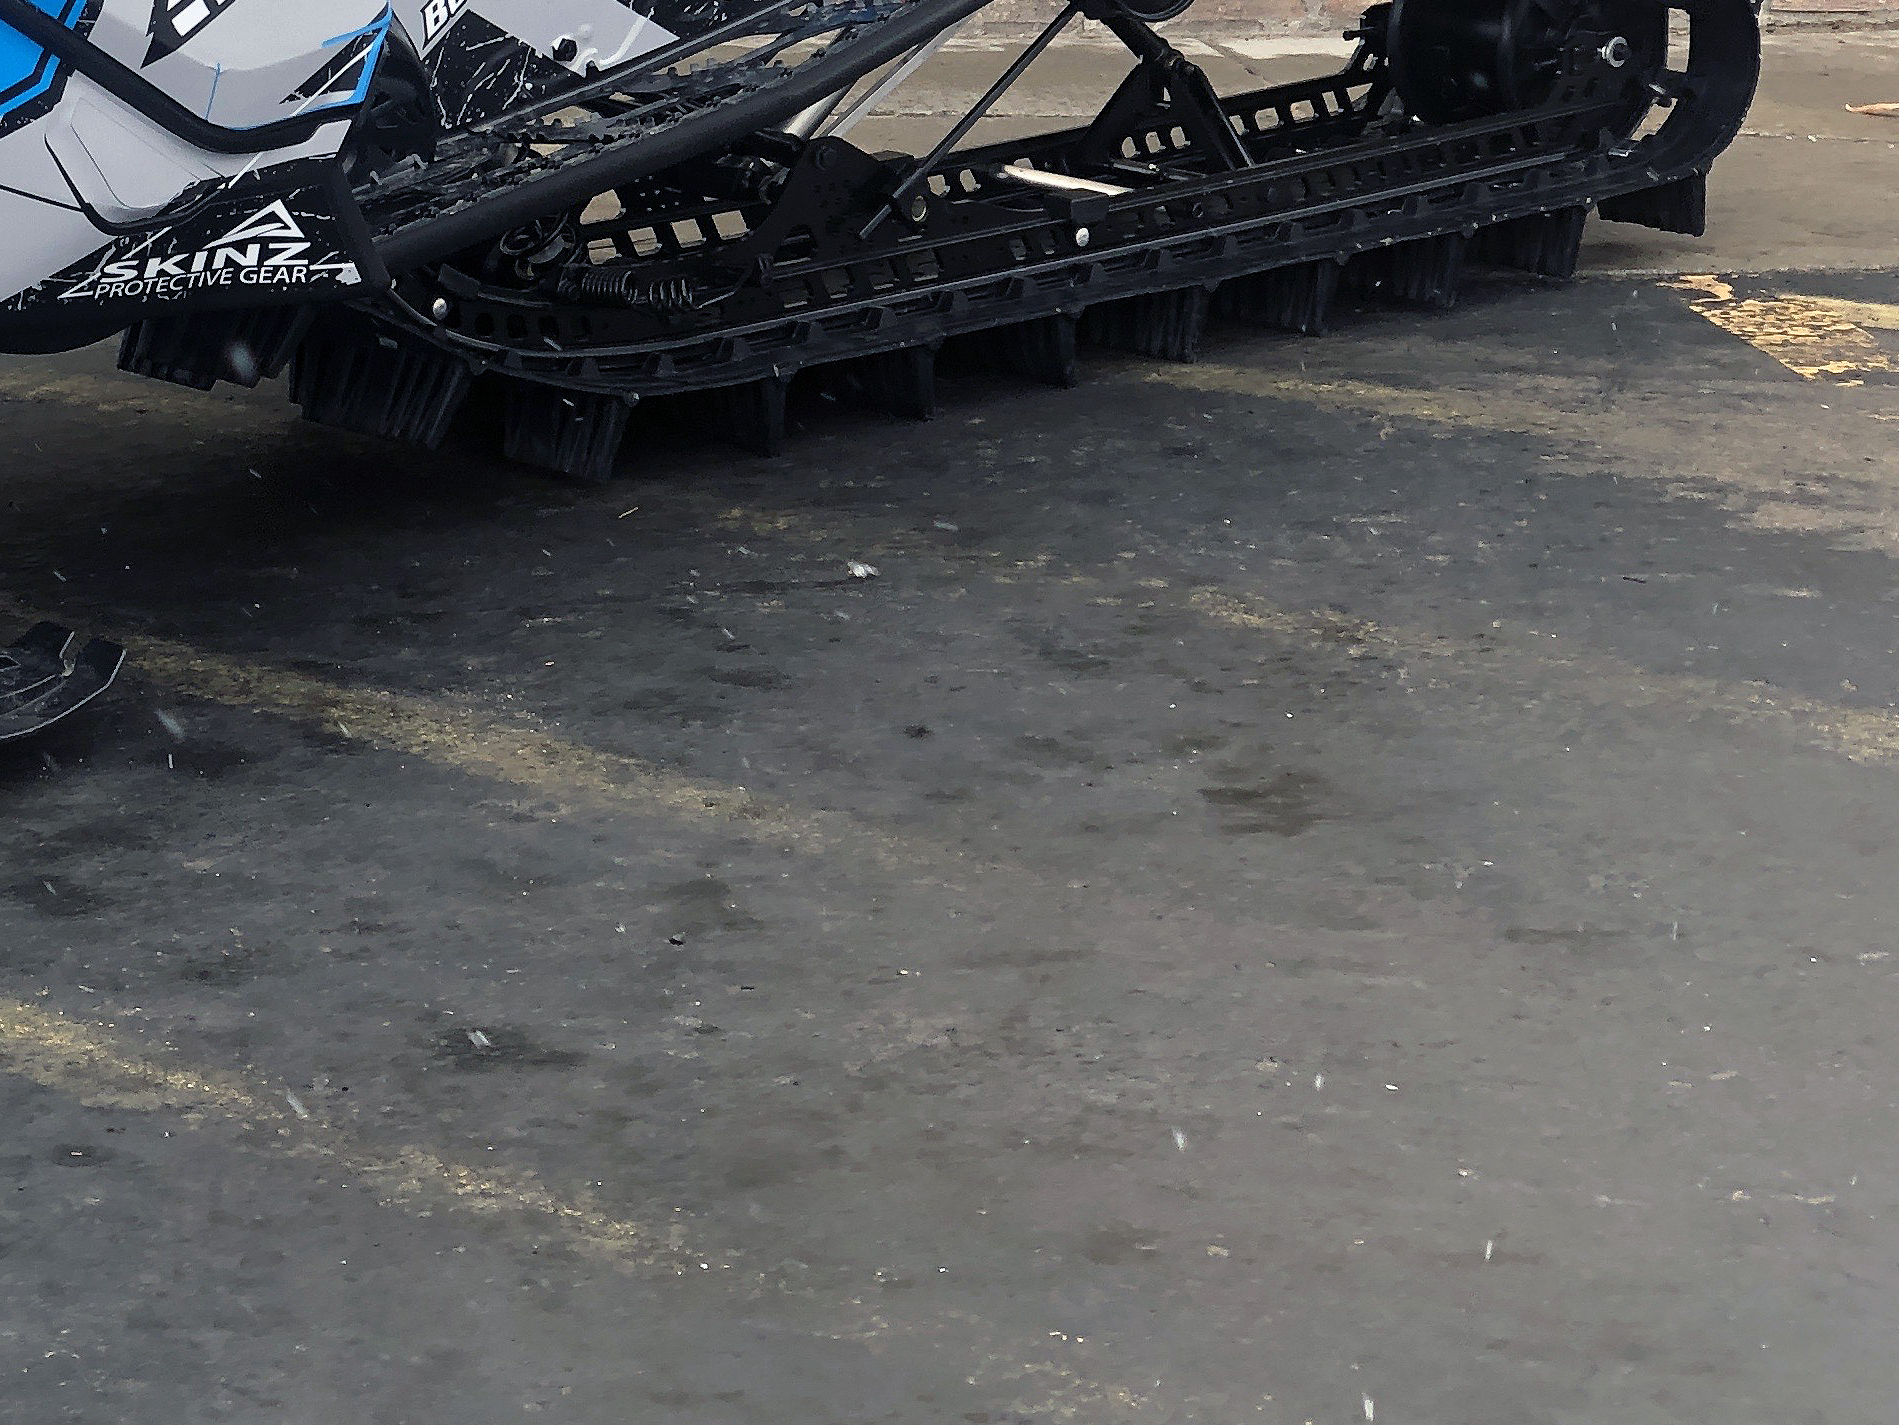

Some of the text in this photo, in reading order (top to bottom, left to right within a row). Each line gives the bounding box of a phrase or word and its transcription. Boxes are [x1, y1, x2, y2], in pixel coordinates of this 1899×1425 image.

[100, 242, 312, 284] SKINZ
[94, 266, 307, 300] PROTECTIVE GEAR
